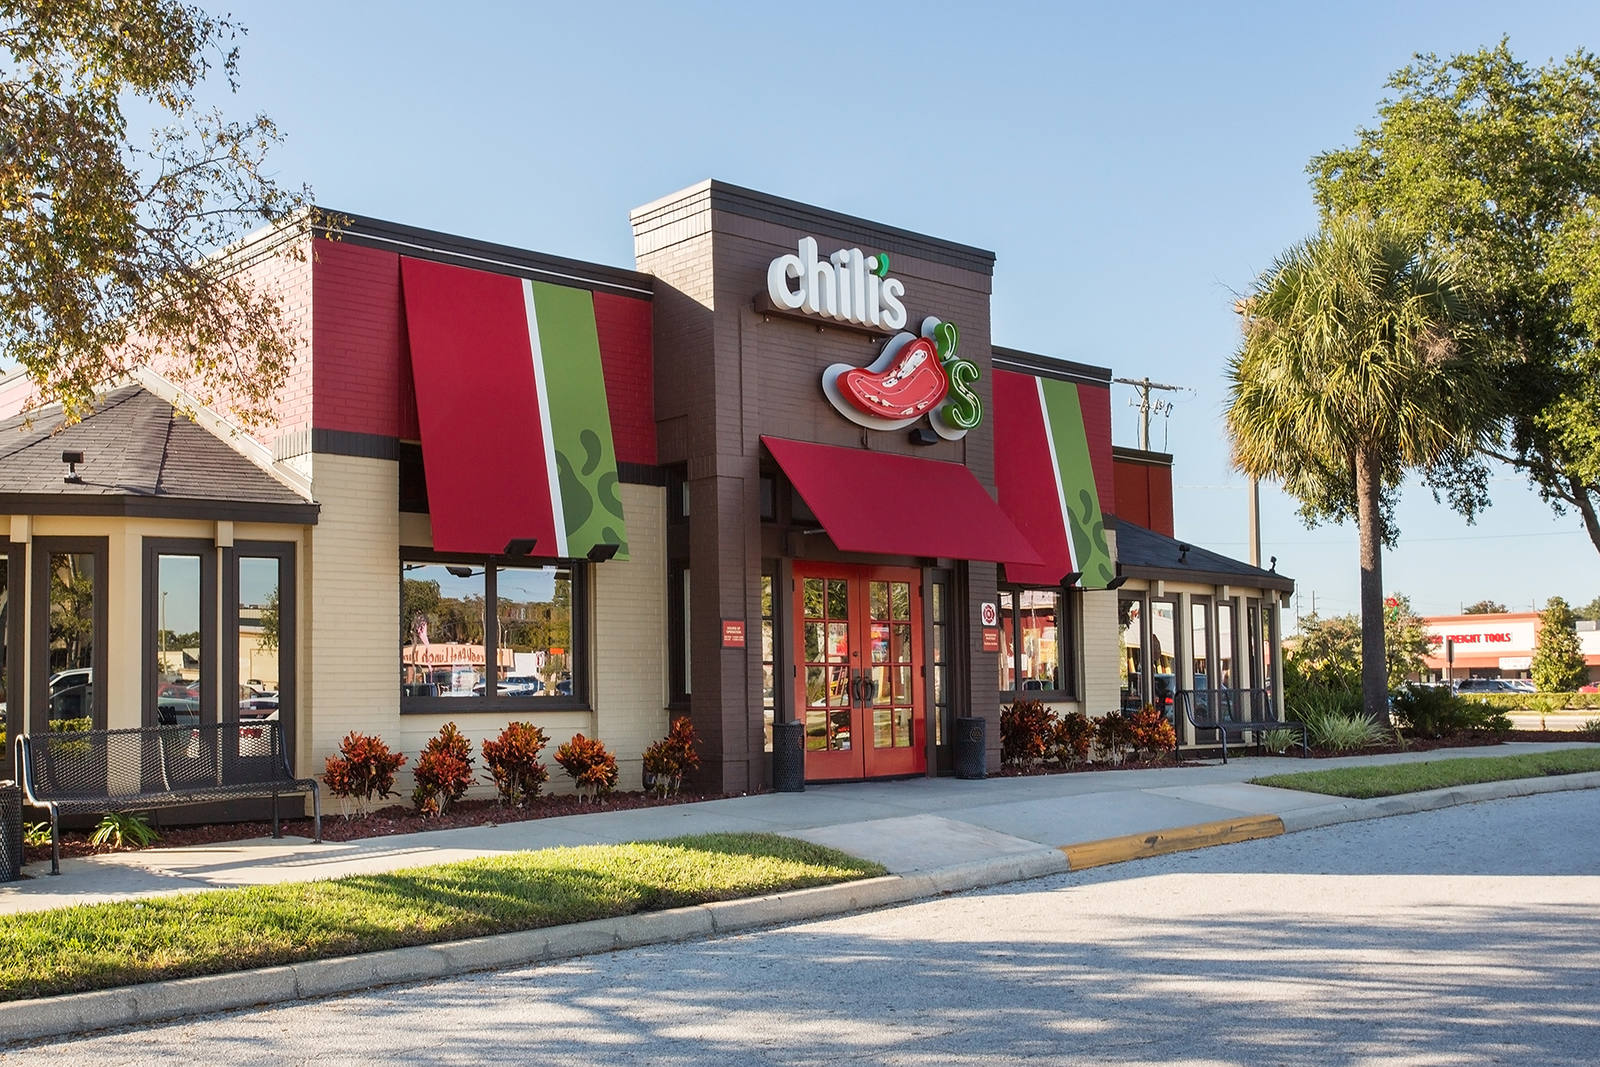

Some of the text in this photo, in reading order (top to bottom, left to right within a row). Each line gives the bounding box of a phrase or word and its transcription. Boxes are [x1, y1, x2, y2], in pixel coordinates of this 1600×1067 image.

[767, 236, 907, 330] chili's
[1446, 633, 1481, 643] FREIGHT
[1484, 633, 1511, 643] TOOLS
